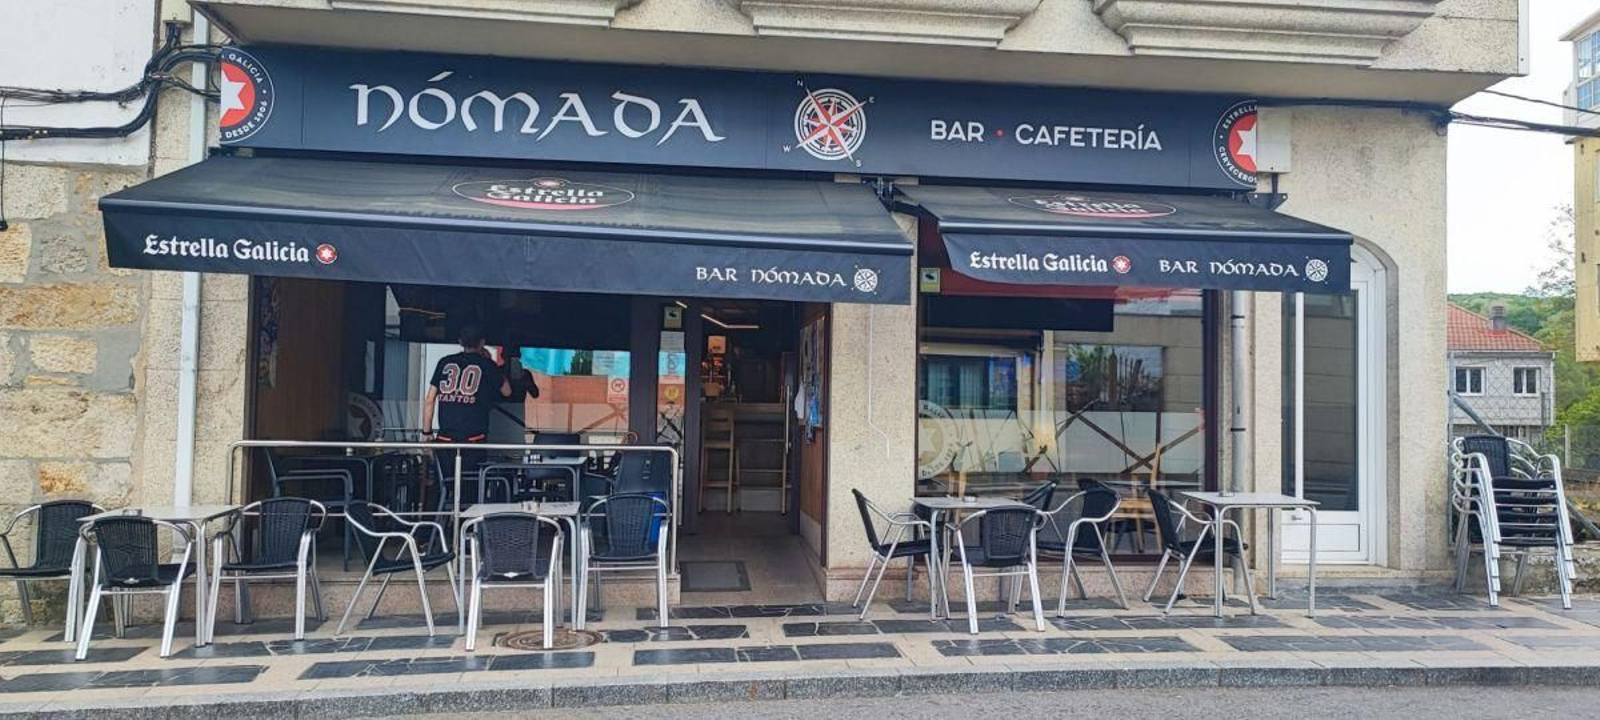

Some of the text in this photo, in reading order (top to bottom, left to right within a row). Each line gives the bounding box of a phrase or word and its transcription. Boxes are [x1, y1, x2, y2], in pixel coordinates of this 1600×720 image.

[228, 53, 263, 83] GALICIA
[225, 121, 255, 138] DESDE
[930, 119, 1163, 151] BAR CAFETERÍA
[143, 234, 310, 262] Estrella Galicia
[969, 251, 1109, 273] Estrella Galicia
[1159, 259, 1200, 274] BAR
[695, 267, 738, 282] BAR
[439, 363, 482, 395] 30
[438, 394, 476, 404] TANTOS
